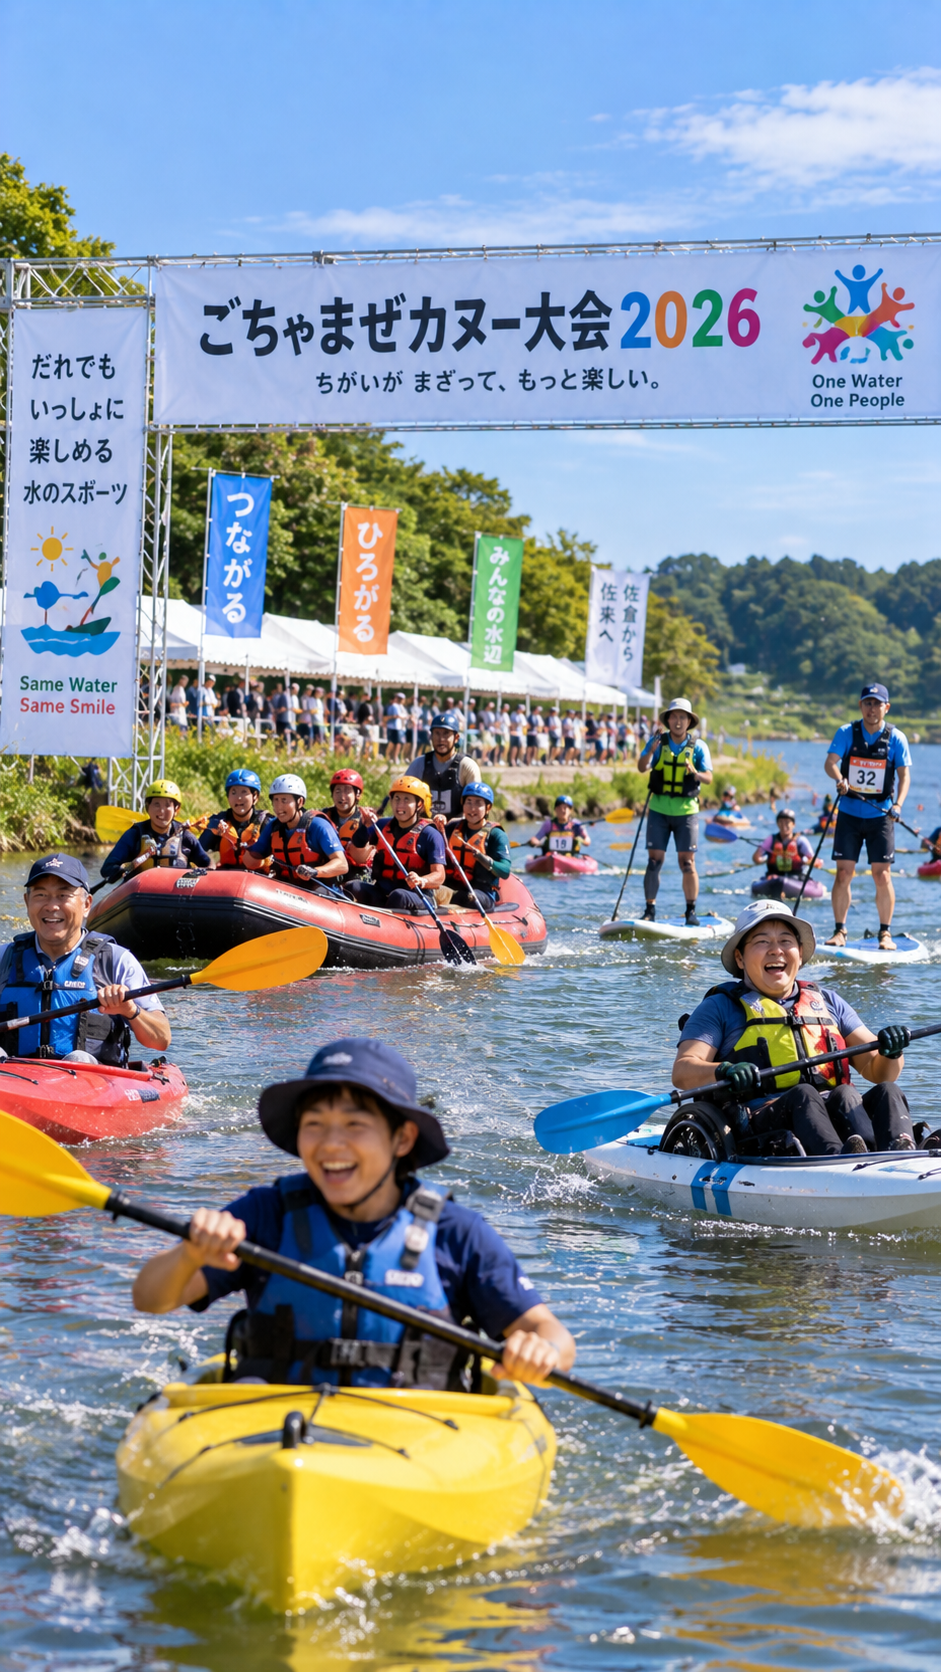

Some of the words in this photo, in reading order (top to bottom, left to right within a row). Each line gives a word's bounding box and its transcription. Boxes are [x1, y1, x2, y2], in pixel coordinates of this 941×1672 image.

[31, 353, 116, 380] だれでも
[315, 370, 404, 395] ちがいが
[812, 374, 846, 389] One
[851, 373, 903, 389] Water
[30, 396, 124, 421] いっしょに
[810, 393, 844, 408] One
[849, 392, 905, 411] People
[29, 436, 113, 465] 楽しめる
[23, 479, 128, 505] 水のスポーツ
[222, 492, 255, 624] つながる
[353, 521, 384, 642] ひろがる
[483, 546, 510, 665] みんなの水辺
[20, 675, 64, 692] Same
[69, 676, 118, 694] Water
[20, 697, 65, 714] Same
[70, 698, 116, 715] Smile
[856, 769, 876, 786] 32
